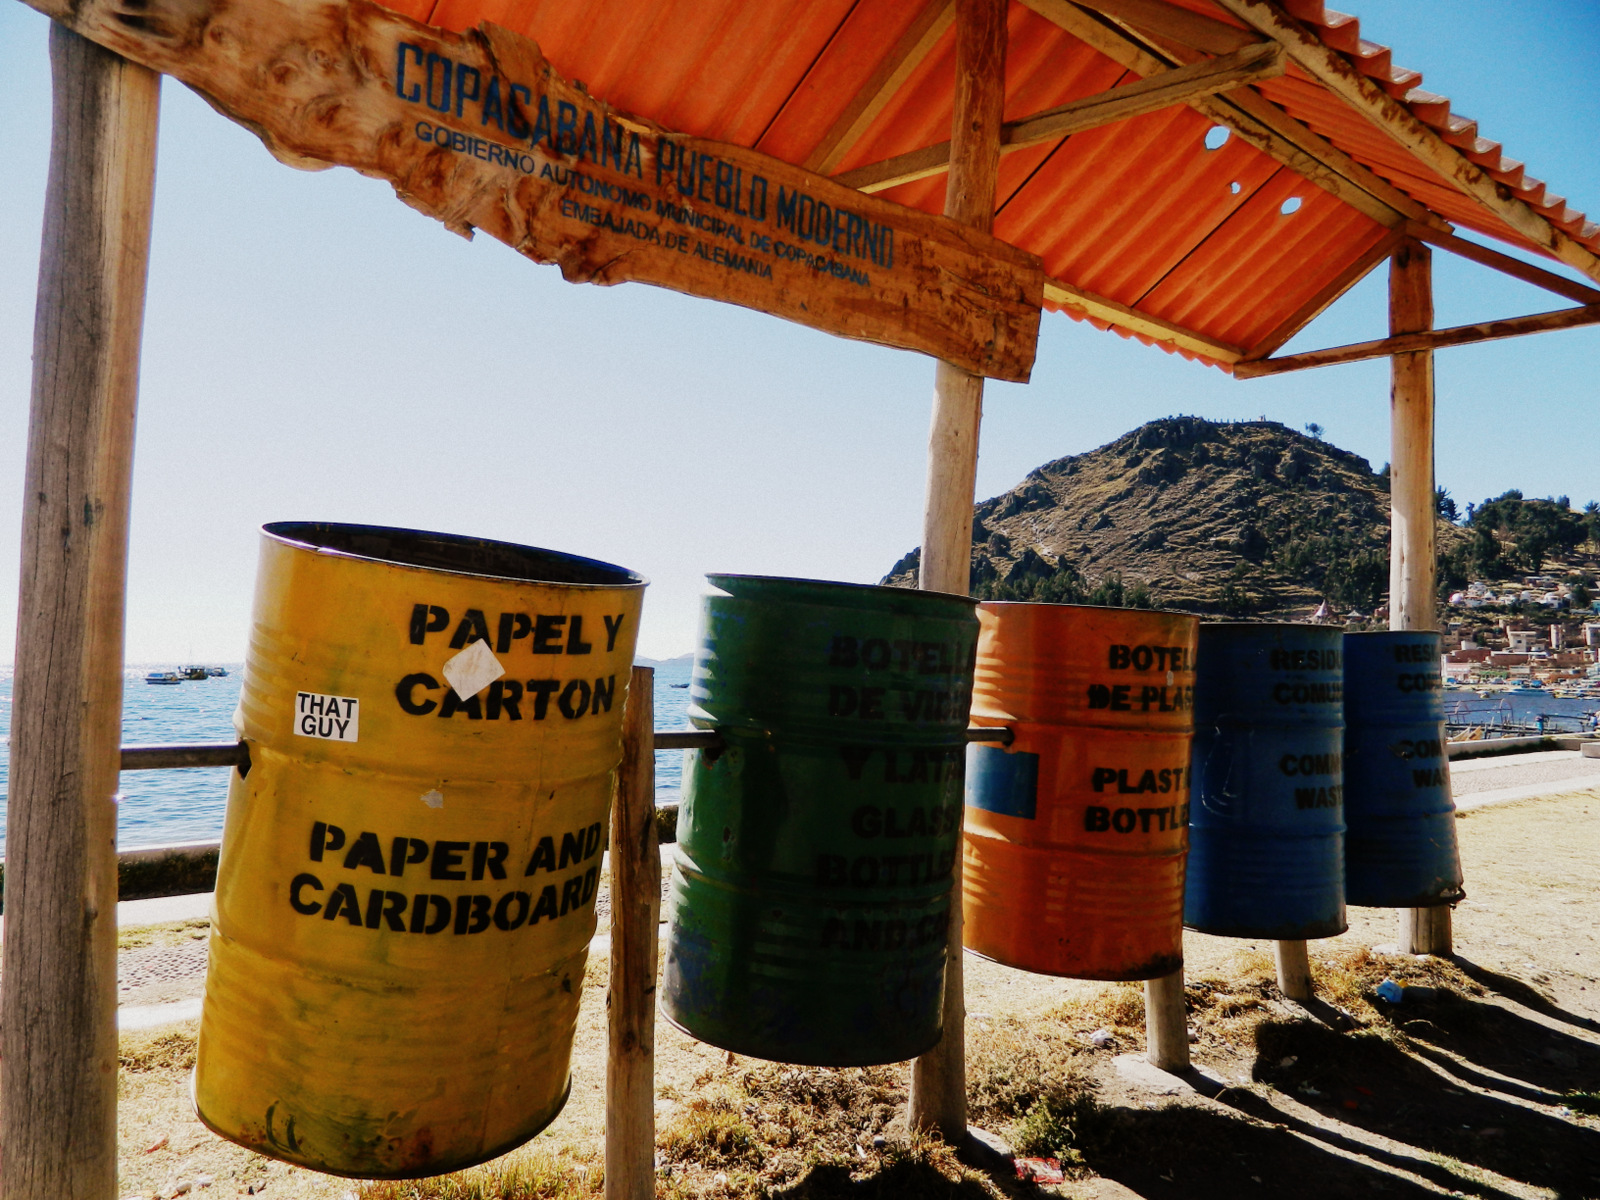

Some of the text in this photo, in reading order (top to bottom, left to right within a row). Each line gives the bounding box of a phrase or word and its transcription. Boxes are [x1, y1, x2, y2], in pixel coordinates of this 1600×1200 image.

[396, 40, 894, 270] COPACABANA PUEBLO MODERNO
[415, 121, 871, 287] GOBIERNO AUTONOMO MUNICIPAL DE COPACABANA
[561, 199, 773, 282] EMBAJADA DE ALEMANIA
[297, 692, 357, 720] THAT
[300, 714, 350, 740] GUY
[395, 672, 616, 722] CARTON
[1087, 683, 1131, 712] DE
[309, 820, 602, 882] PAPER AND
[289, 867, 598, 936] CARDBOARD
